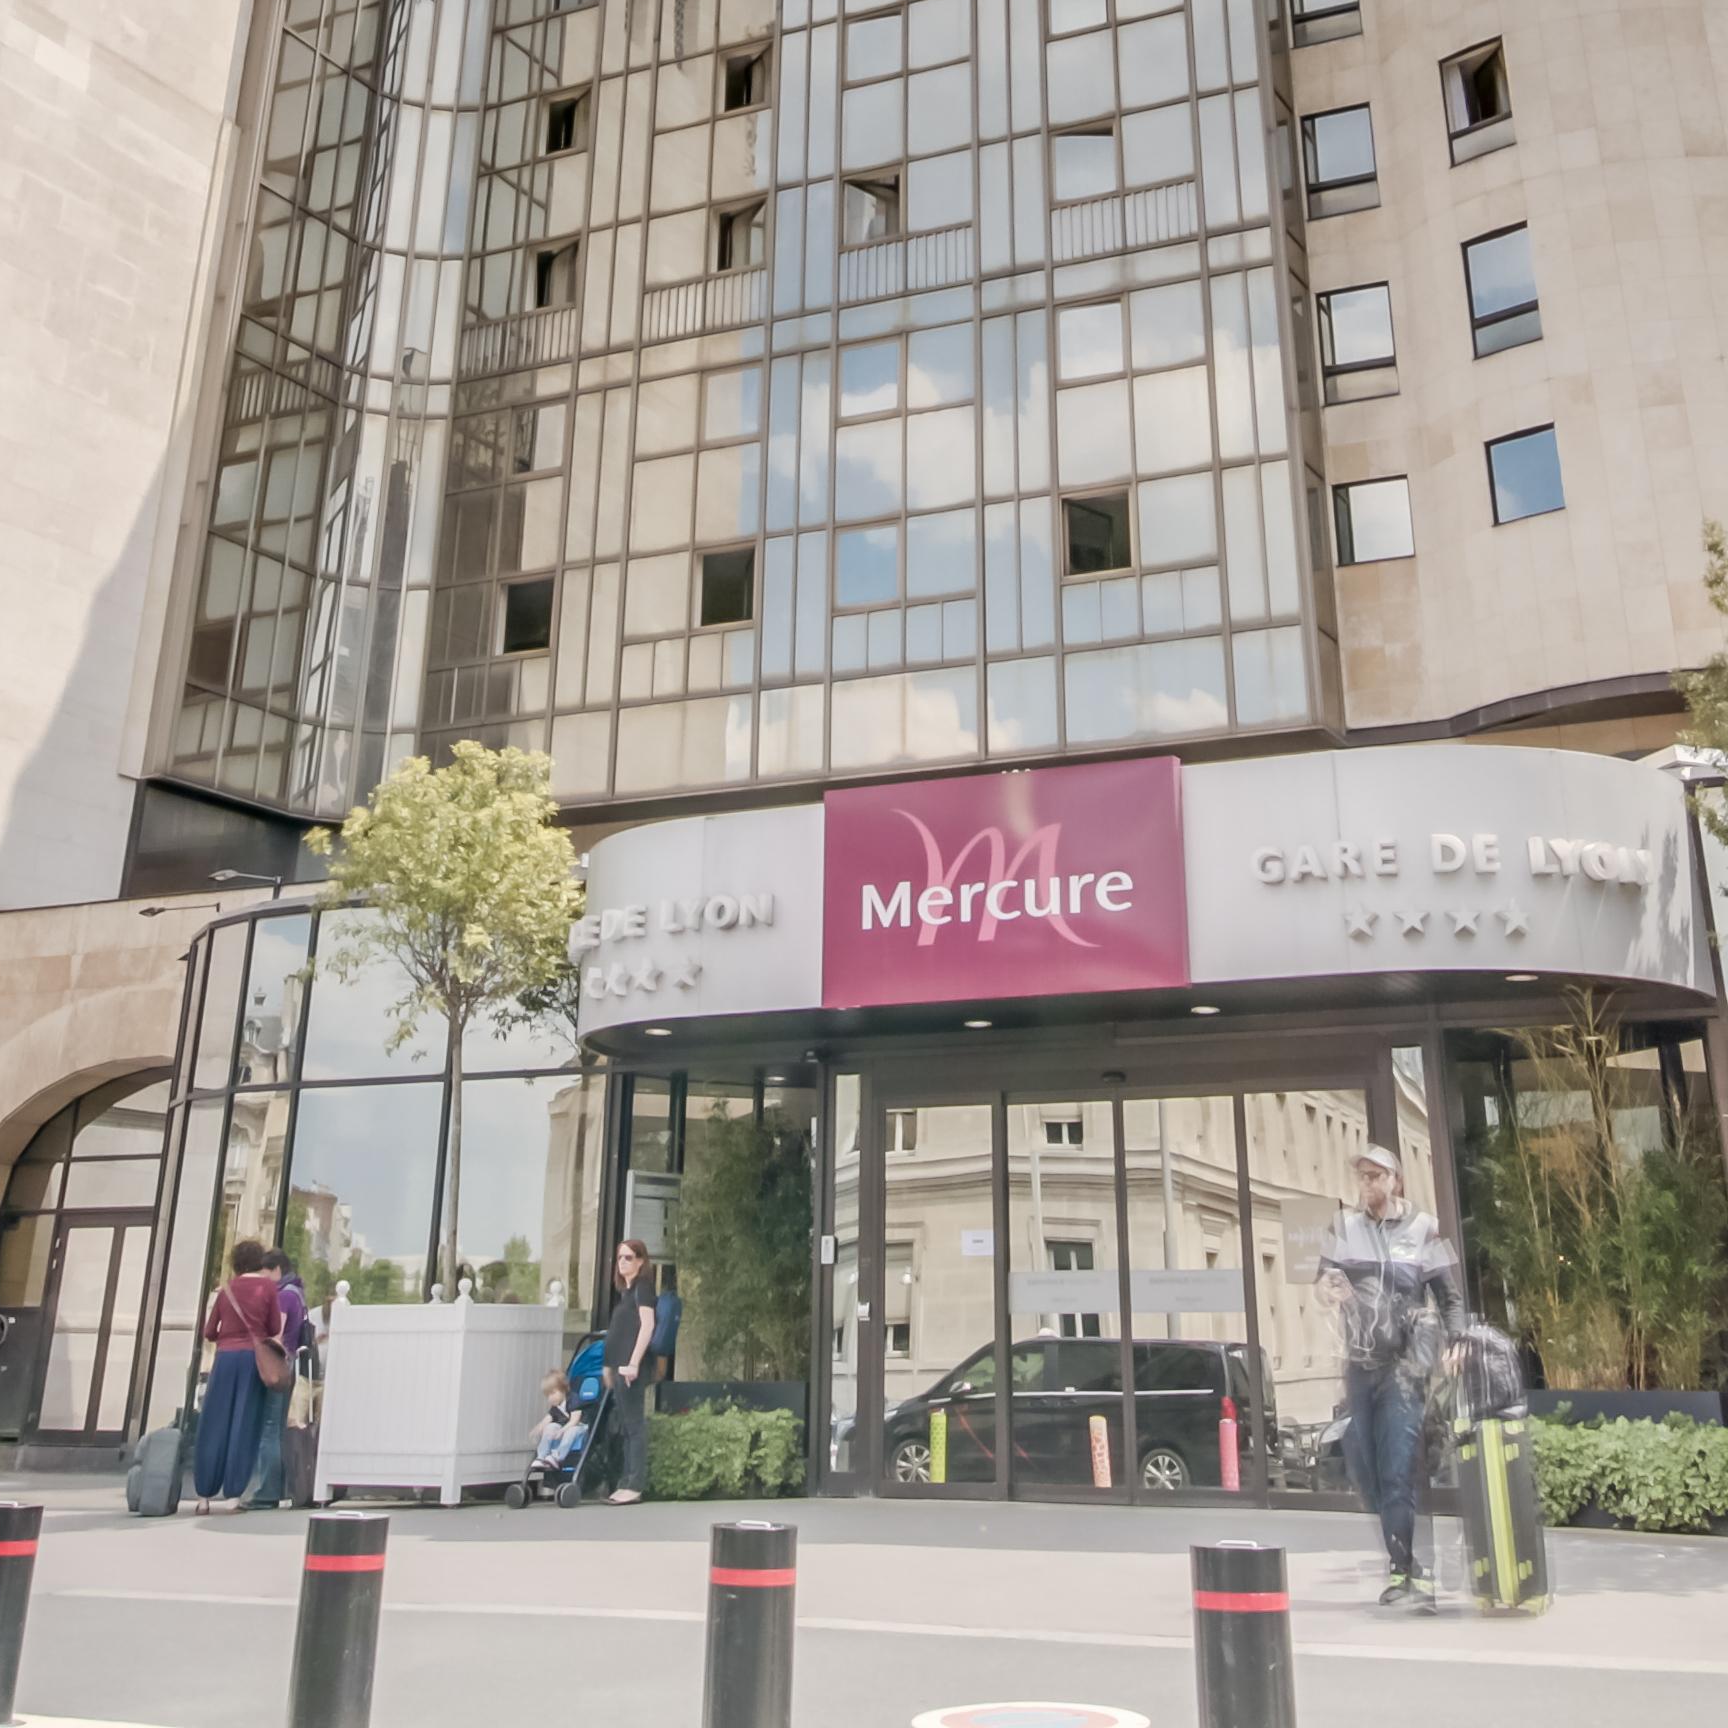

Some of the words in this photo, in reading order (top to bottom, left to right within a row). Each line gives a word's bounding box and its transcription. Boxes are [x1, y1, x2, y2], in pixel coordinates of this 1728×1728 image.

[1253, 838, 1399, 885] GARE
[1430, 832, 1502, 874] DE
[1527, 835, 1652, 888] LYON
[659, 892, 775, 934] LYON
[860, 870, 1135, 931] Mercure
